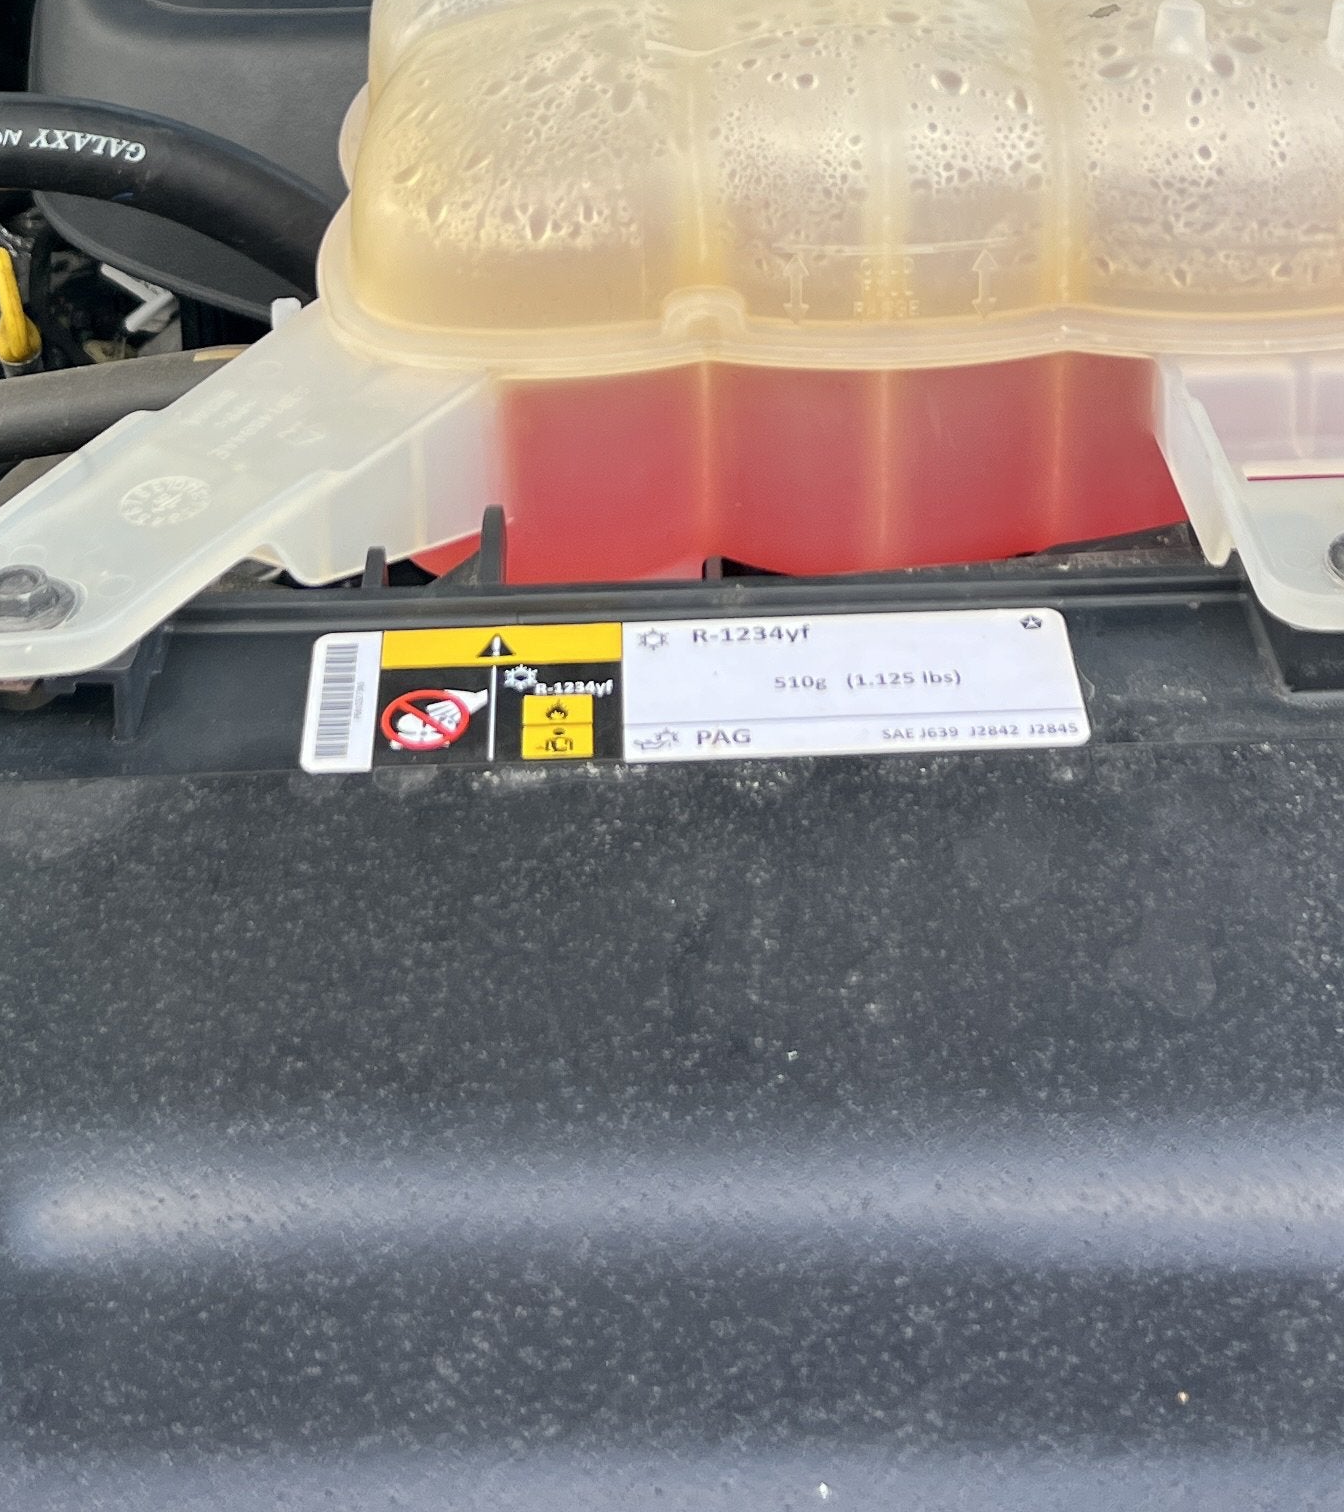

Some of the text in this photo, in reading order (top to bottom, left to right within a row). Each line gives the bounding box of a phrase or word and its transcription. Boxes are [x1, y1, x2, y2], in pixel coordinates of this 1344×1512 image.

[28, 128, 147, 163] GALAXY
[692, 623, 811, 643] R-1234yf
[535, 678, 614, 698] R-1234yf
[774, 669, 961, 691] 510g (1.125 lbs)
[696, 728, 752, 746] PAG
[882, 722, 1079, 740] SAE J639 J2842 J2845
